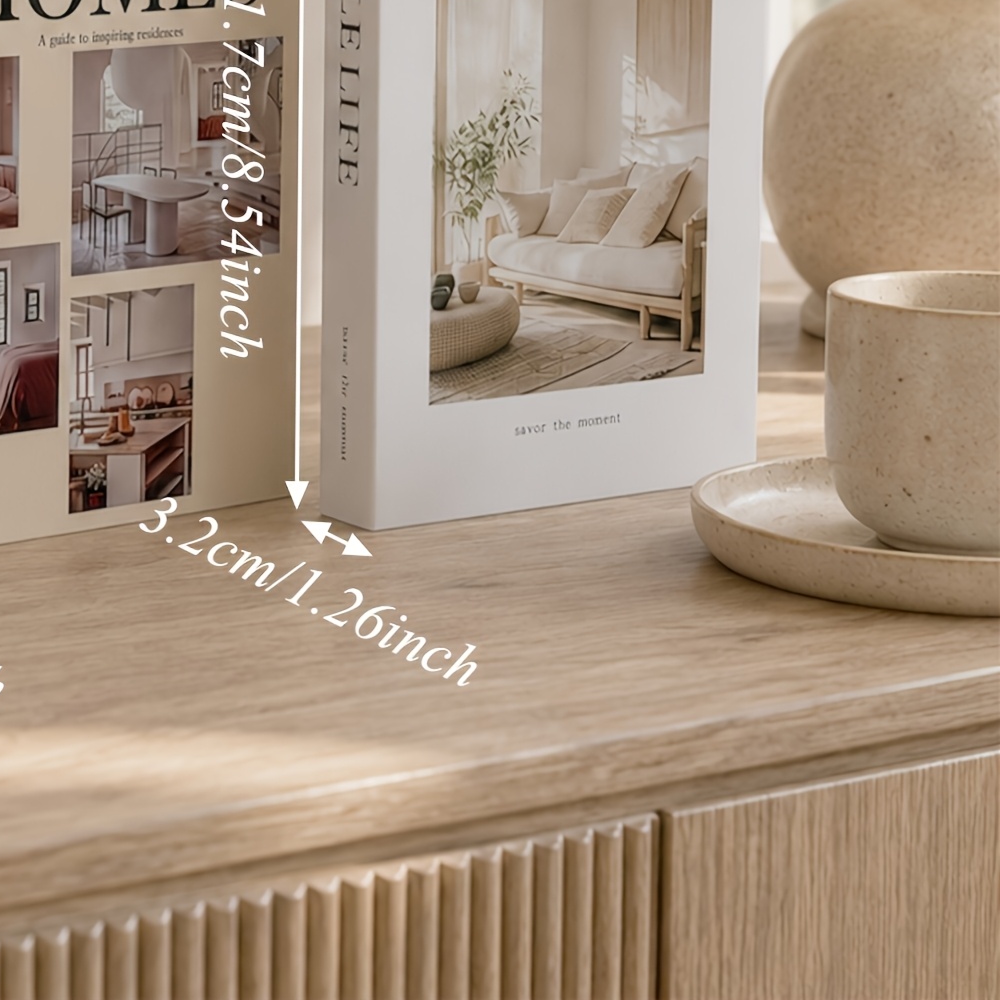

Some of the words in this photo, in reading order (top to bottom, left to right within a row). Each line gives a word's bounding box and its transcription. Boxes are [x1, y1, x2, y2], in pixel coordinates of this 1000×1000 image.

[37, 33, 47, 48] A
[49, 31, 77, 49] guide
[78, 32, 90, 45] to
[338, 64, 361, 188] LIFE
[513, 421, 547, 438] savor
